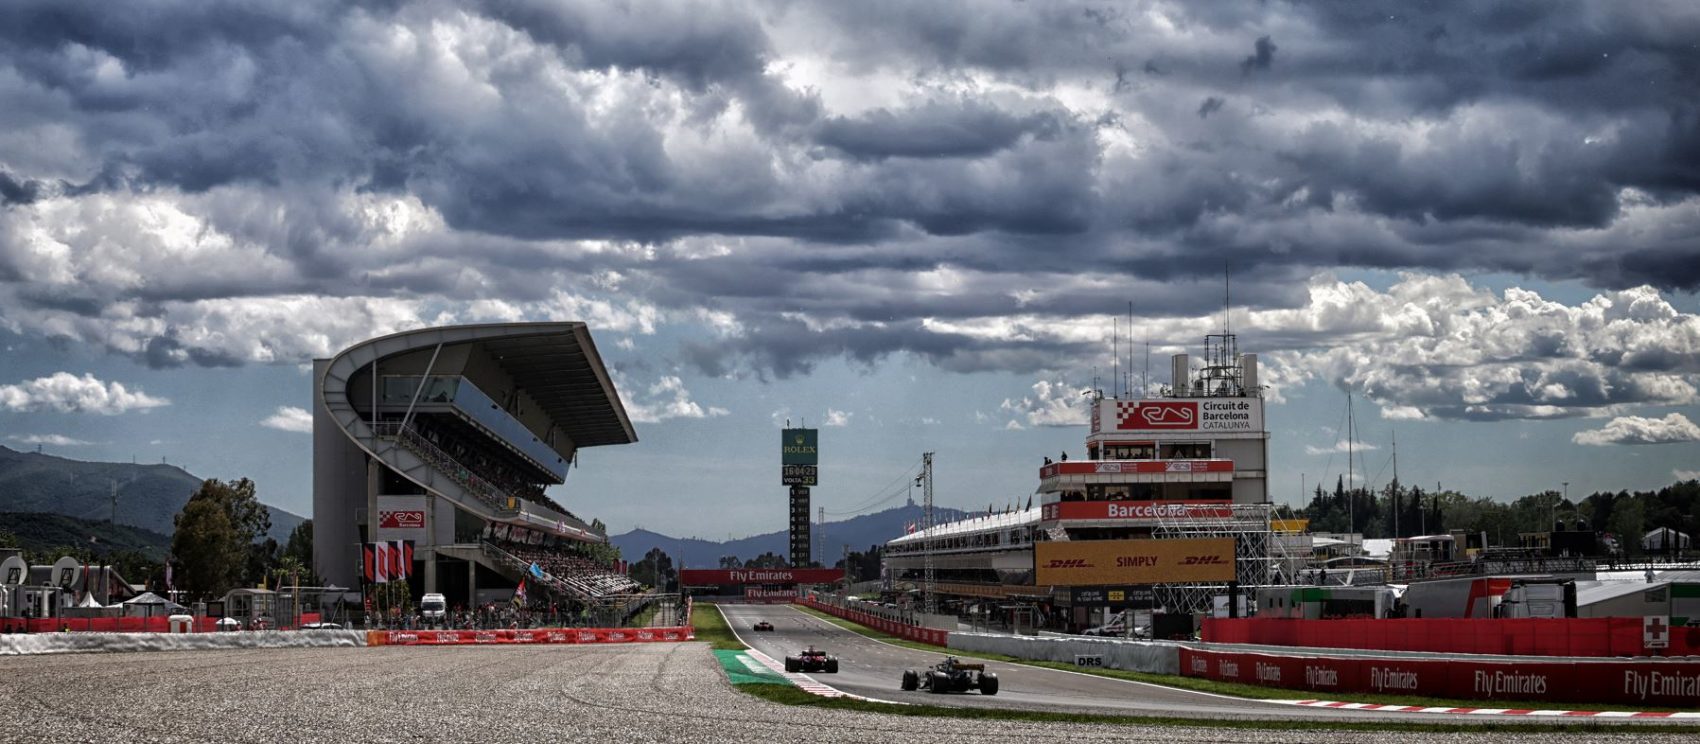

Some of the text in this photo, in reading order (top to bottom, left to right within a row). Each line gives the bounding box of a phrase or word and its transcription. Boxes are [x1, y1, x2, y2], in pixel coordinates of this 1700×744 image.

[1203, 401, 1249, 411] Circuit de
[1203, 412, 1249, 420] Barcelona
[1203, 422, 1250, 430] CATALUNYA
[784, 445, 816, 454] ROLEX
[1108, 502, 1186, 517] Barcelona
[1049, 559, 1089, 569] DHL
[1116, 556, 1158, 567] SIMPLY
[1184, 555, 1225, 565] DHL
[730, 570, 793, 582] Fly Emirates
[748, 588, 798, 598] Fly Emirates
[1078, 657, 1102, 666] DRS
[1256, 661, 1281, 684] Fly Emirates
[1306, 665, 1338, 688] Fly Emirates
[1371, 667, 1418, 692] Fly Emirates
[1475, 670, 1547, 697] Fly Emirates
[1624, 670, 1648, 700] Fly
